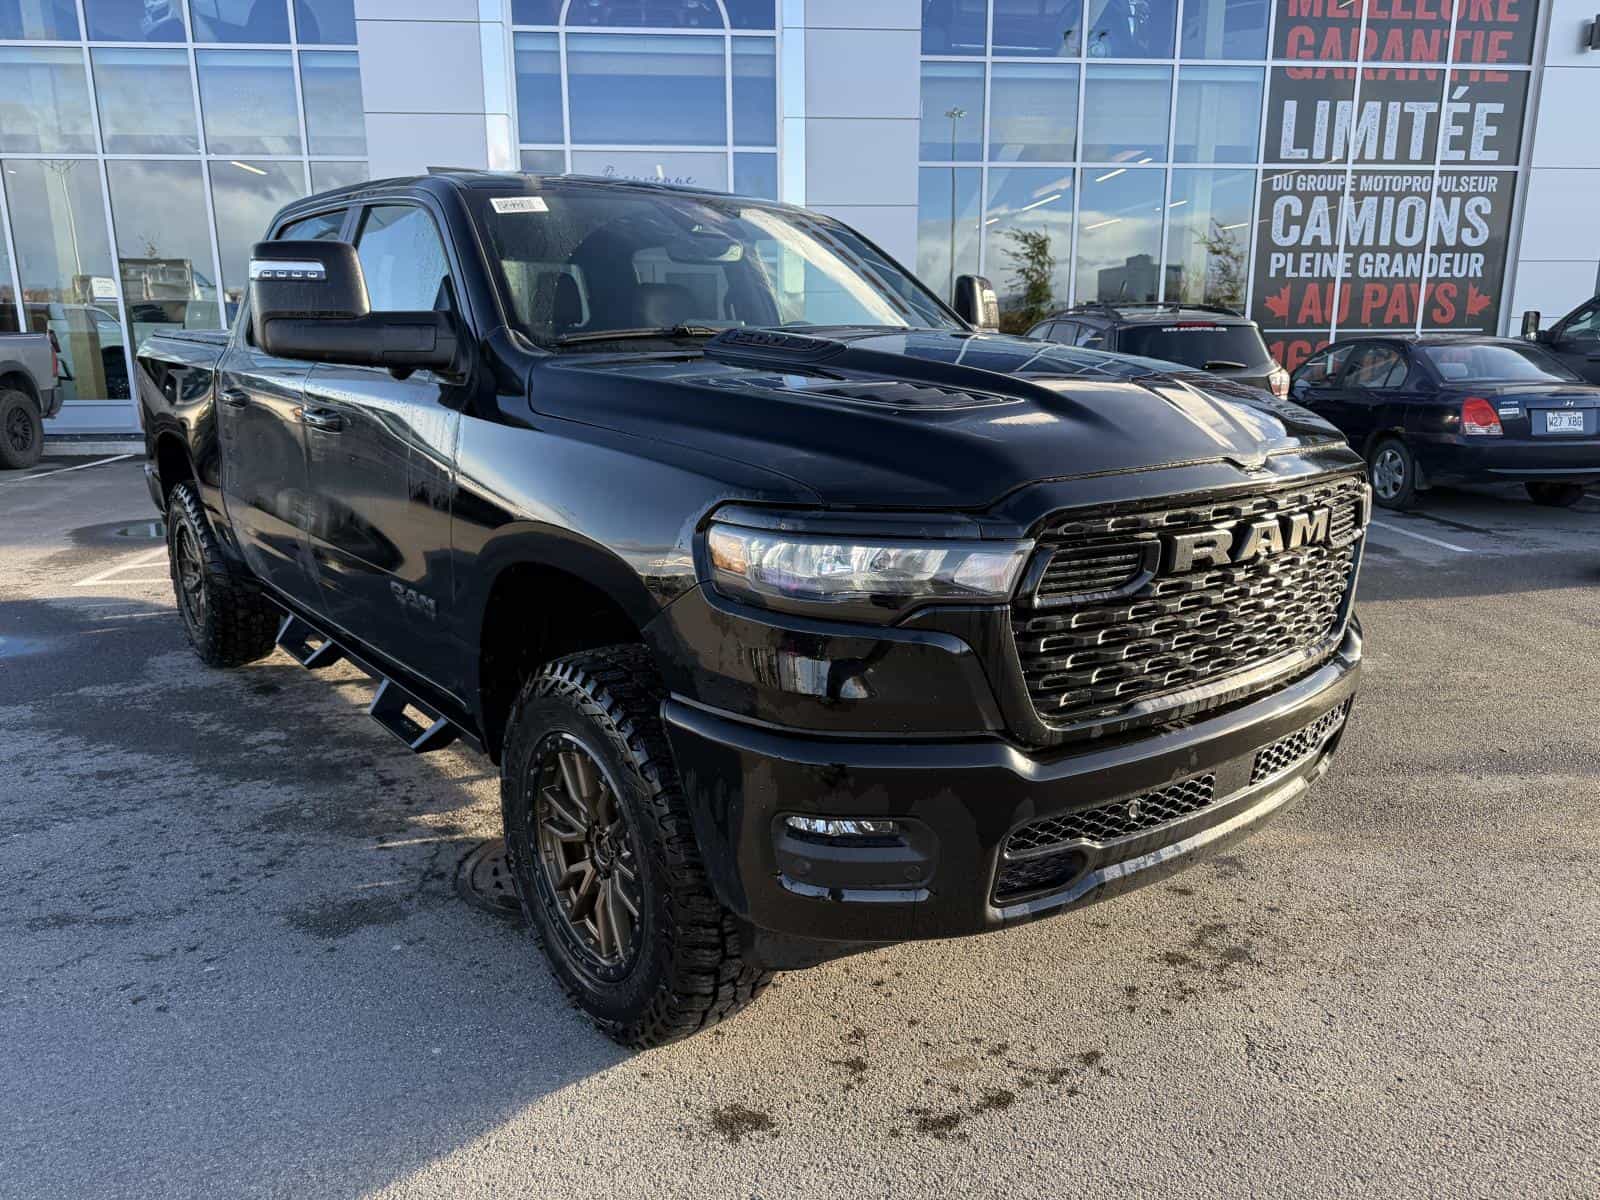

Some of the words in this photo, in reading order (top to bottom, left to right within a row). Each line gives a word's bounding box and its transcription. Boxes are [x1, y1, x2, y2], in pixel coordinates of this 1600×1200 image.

[1285, 25, 1514, 82] GARANTIE
[1279, 86, 1505, 161] LIMITÉE
[1272, 174, 1293, 192] DU
[1296, 174, 1357, 192] GROUPE
[1271, 195, 1492, 247] CAMIONS
[1269, 253, 1353, 278] PLEINE
[1358, 252, 1485, 278] GRANDEUR
[1297, 282, 1352, 324] AU
[1361, 282, 1458, 324] PAYS
[1173, 507, 1330, 573] RAM
[390, 581, 437, 621] RAM
